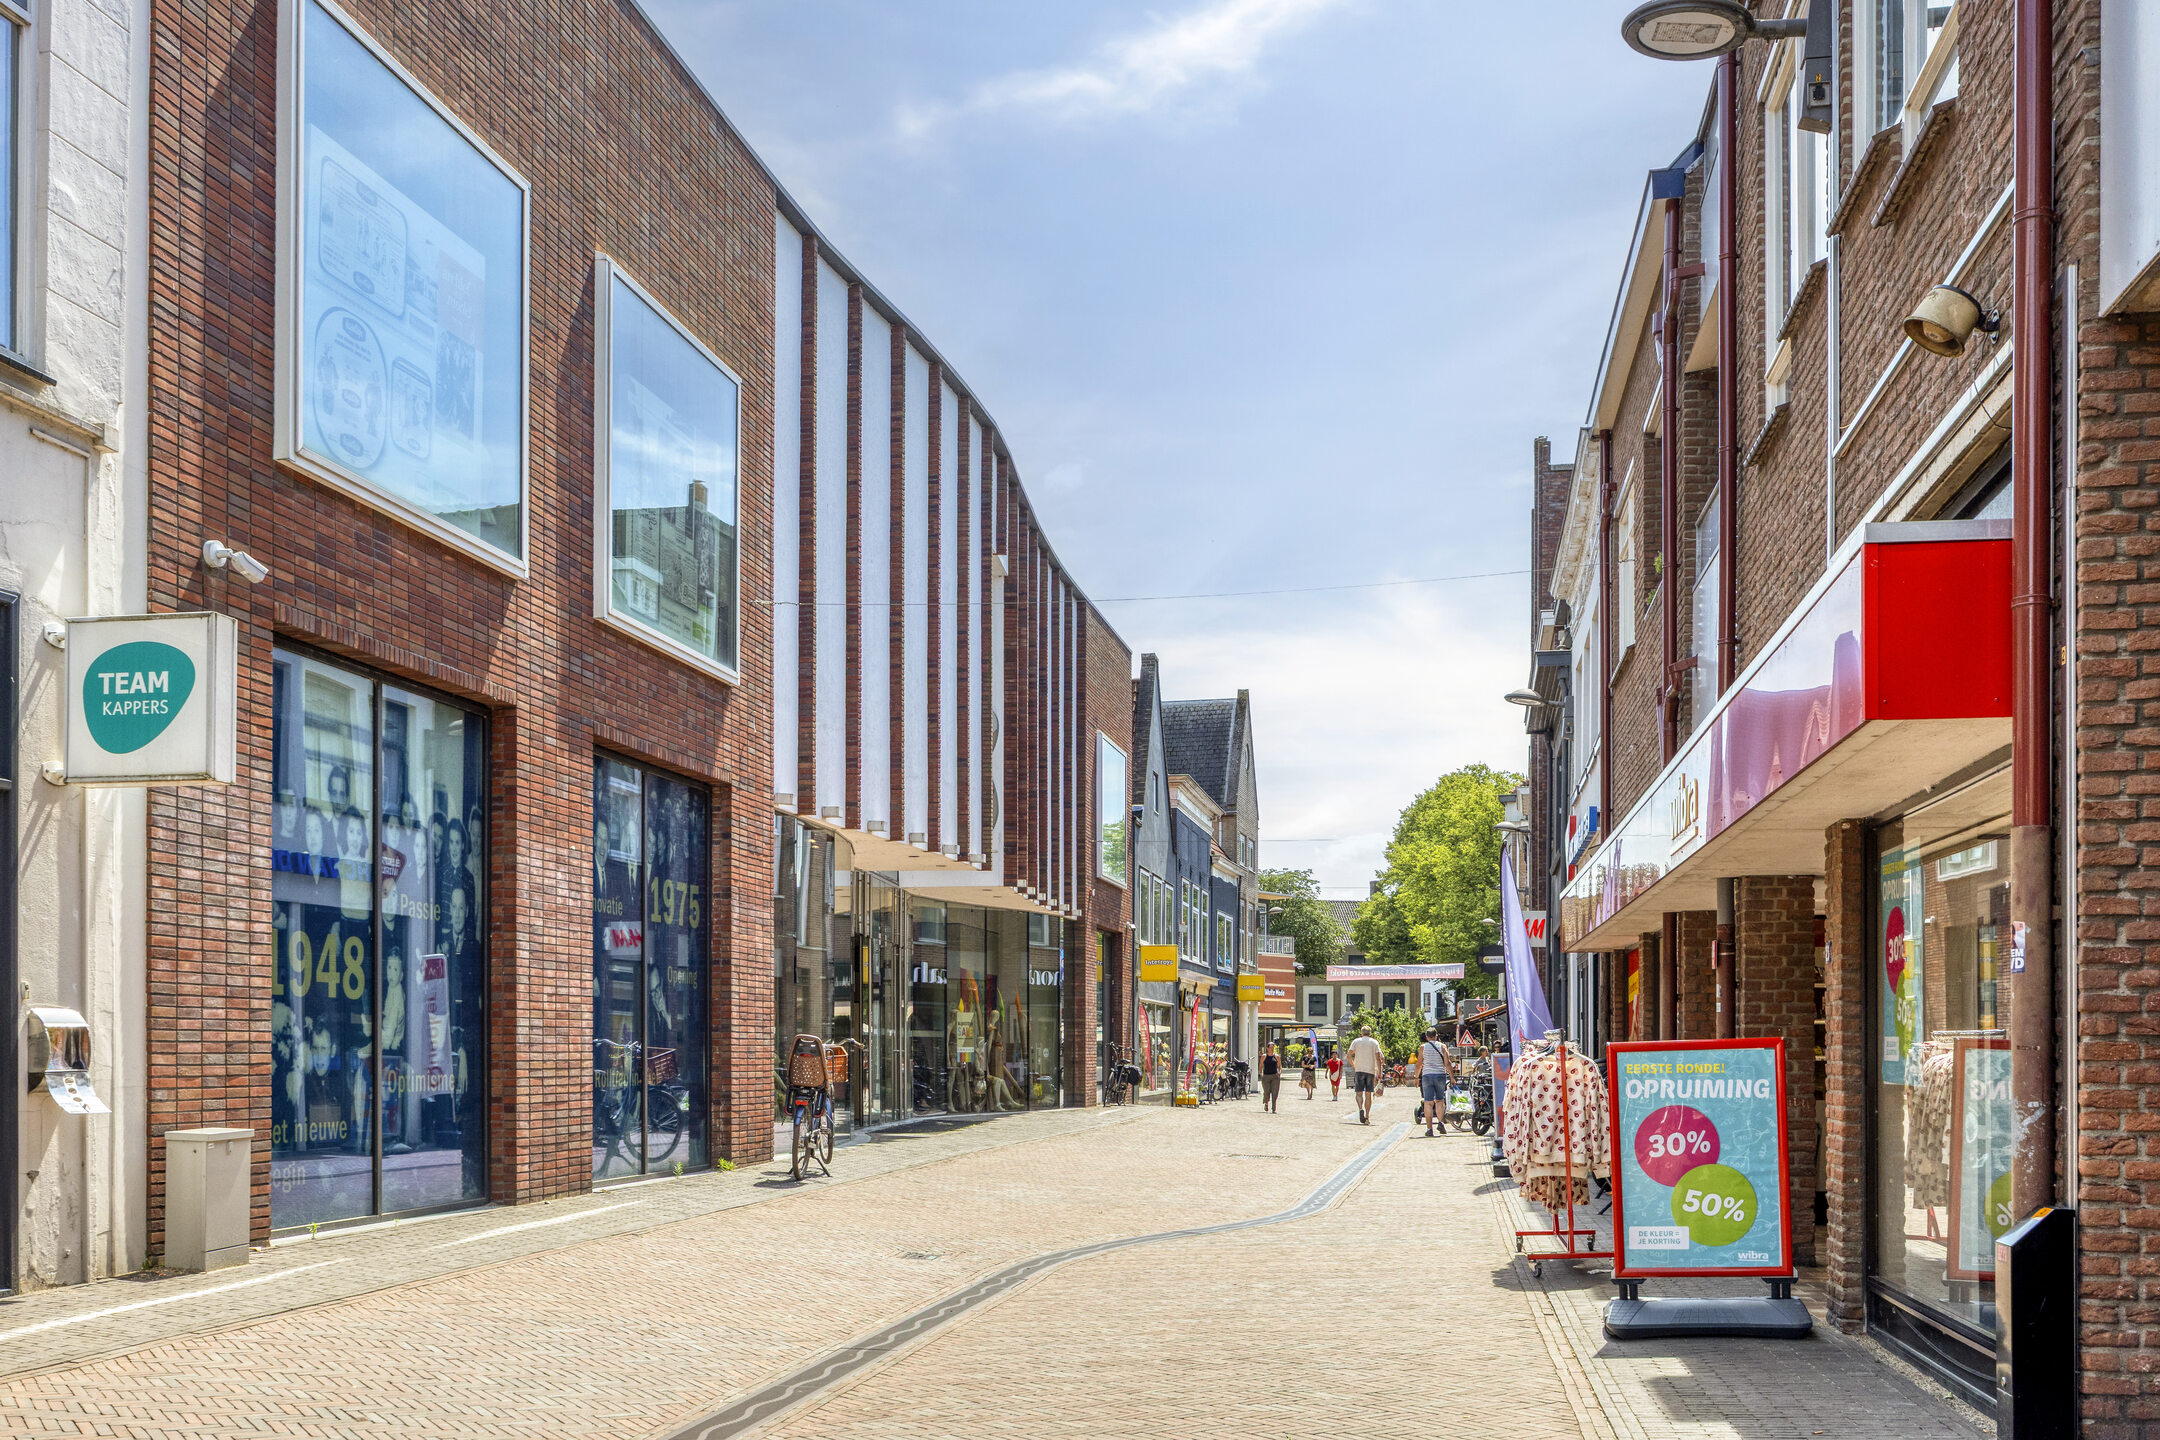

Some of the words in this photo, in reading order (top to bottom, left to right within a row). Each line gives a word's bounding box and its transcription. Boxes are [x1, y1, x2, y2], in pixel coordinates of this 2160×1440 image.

[98, 671, 169, 695] TEAM
[102, 699, 169, 716] KAPPERS
[1671, 773, 1698, 841] wibra
[400, 894, 441, 921] Passie
[593, 897, 623, 917] novatie
[650, 876, 699, 928] 1975
[272, 928, 365, 1000] 1948
[667, 965, 698, 990] Opening
[1626, 1063, 1673, 1074] EERSTE
[1676, 1063, 1725, 1074] RONDE!
[388, 1069, 455, 1098] Optimisme
[1625, 1078, 1770, 1099] OPRUIMING
[272, 1119, 289, 1144] et
[294, 1116, 347, 1143] nieuwe
[1648, 1130, 1711, 1158] 30%
[272, 1161, 306, 1193] egin
[1682, 1189, 1745, 1222] 50%
[1738, 1250, 1769, 1260] wibra
